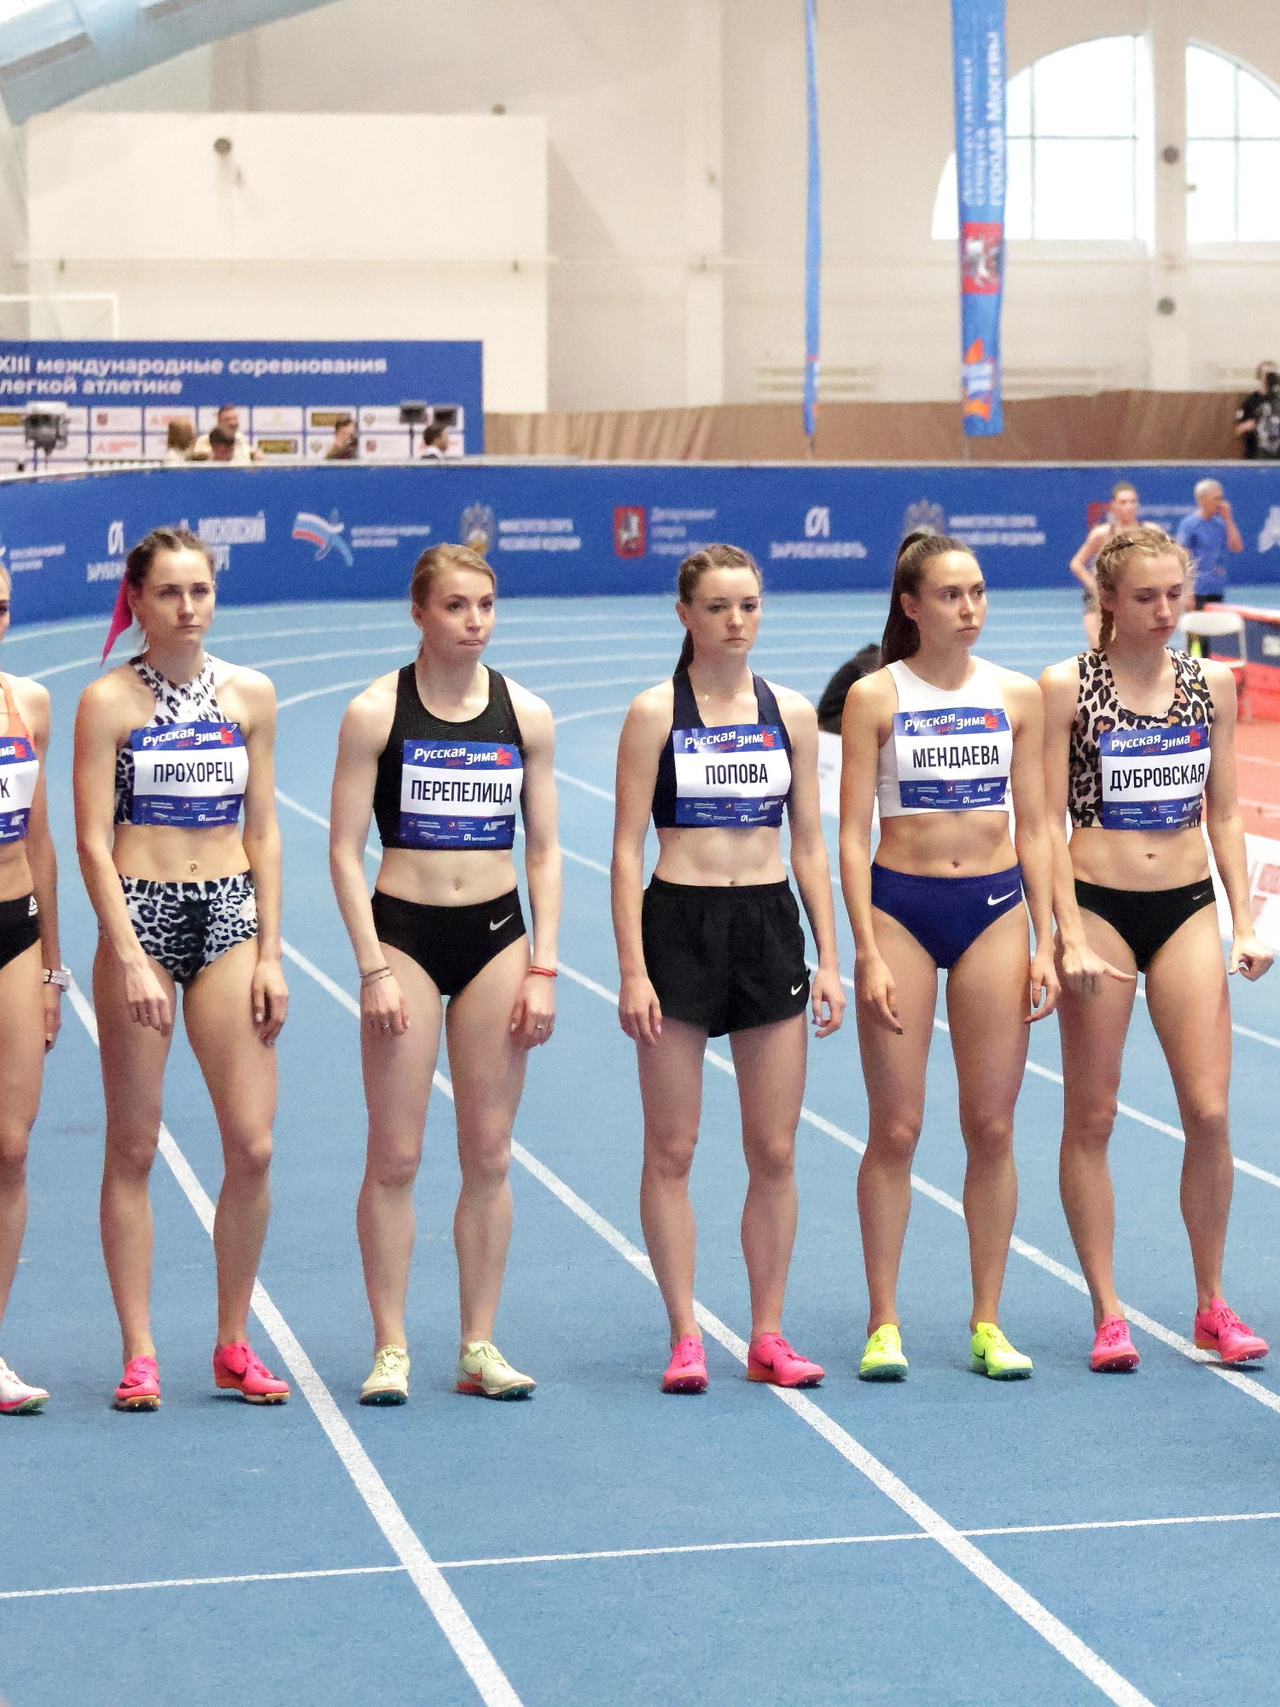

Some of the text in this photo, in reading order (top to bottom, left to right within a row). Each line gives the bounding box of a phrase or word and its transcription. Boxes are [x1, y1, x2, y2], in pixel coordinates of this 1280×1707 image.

[36, 358, 387, 379] международные соревнования
[82, 379, 183, 395] атлетике
[904, 714, 956, 732] Русская
[143, 728, 195, 746] Русская
[684, 731, 736, 749] Русская
[1111, 735, 1161, 752] Русская
[414, 748, 466, 762] Русская
[912, 745, 999, 769] МЕНДАЕВА
[153, 762, 234, 784] ПРОХОРЕЦ
[705, 764, 768, 785] ПОПОВА
[1110, 763, 1205, 791] ДУБРОВСКАЯ
[411, 780, 512, 805] ПЕРЕПЕЛИЦА
